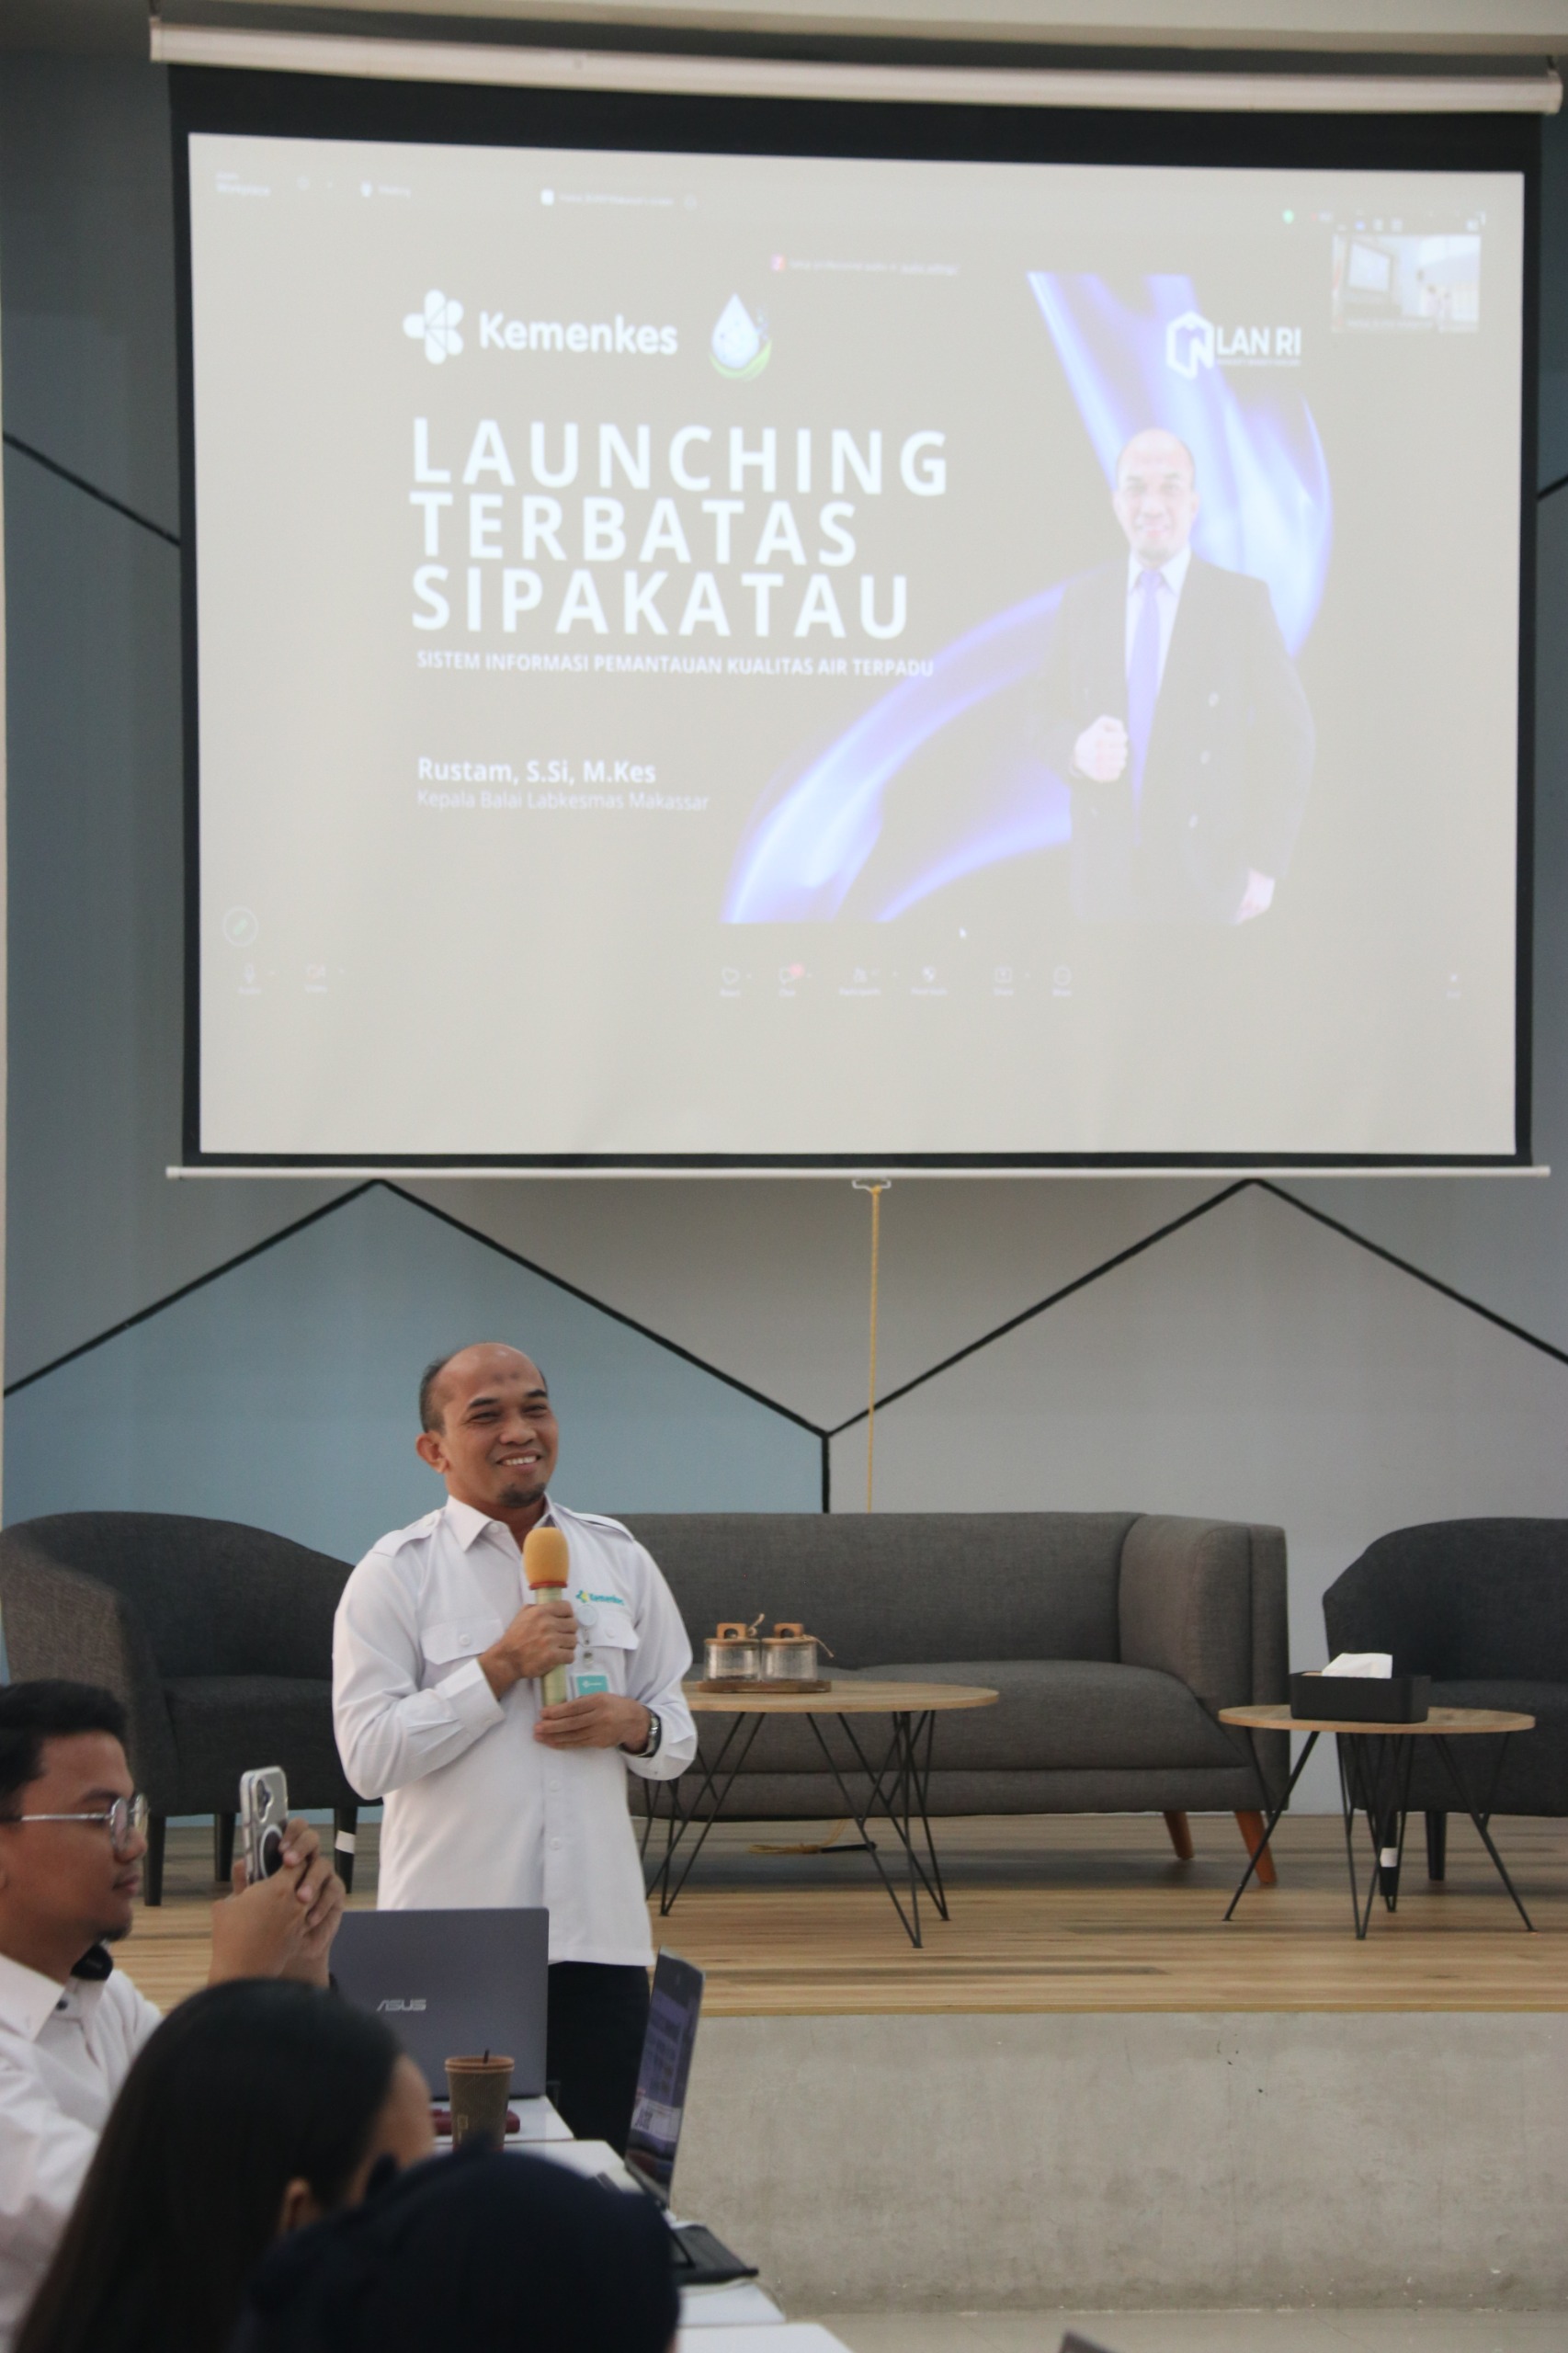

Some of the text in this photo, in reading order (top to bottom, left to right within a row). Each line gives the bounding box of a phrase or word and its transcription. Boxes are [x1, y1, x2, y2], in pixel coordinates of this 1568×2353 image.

[480, 312, 677, 354] Kemenkes
[1219, 326, 1301, 356] LAN RI
[411, 416, 948, 497] LAUNCHING
[409, 491, 858, 567] TERBATAS
[412, 564, 908, 640] SIPAKATAU
[417, 651, 935, 677] SISTEM INFORMASI PEMANTAUAN KUALITAS AIR TERPADU
[418, 757, 655, 785] Rustam, S.Si, M.Kes
[417, 790, 709, 811] Kepala Balai Labkesmas Makassar
[376, 1998, 426, 2011] ASUS
